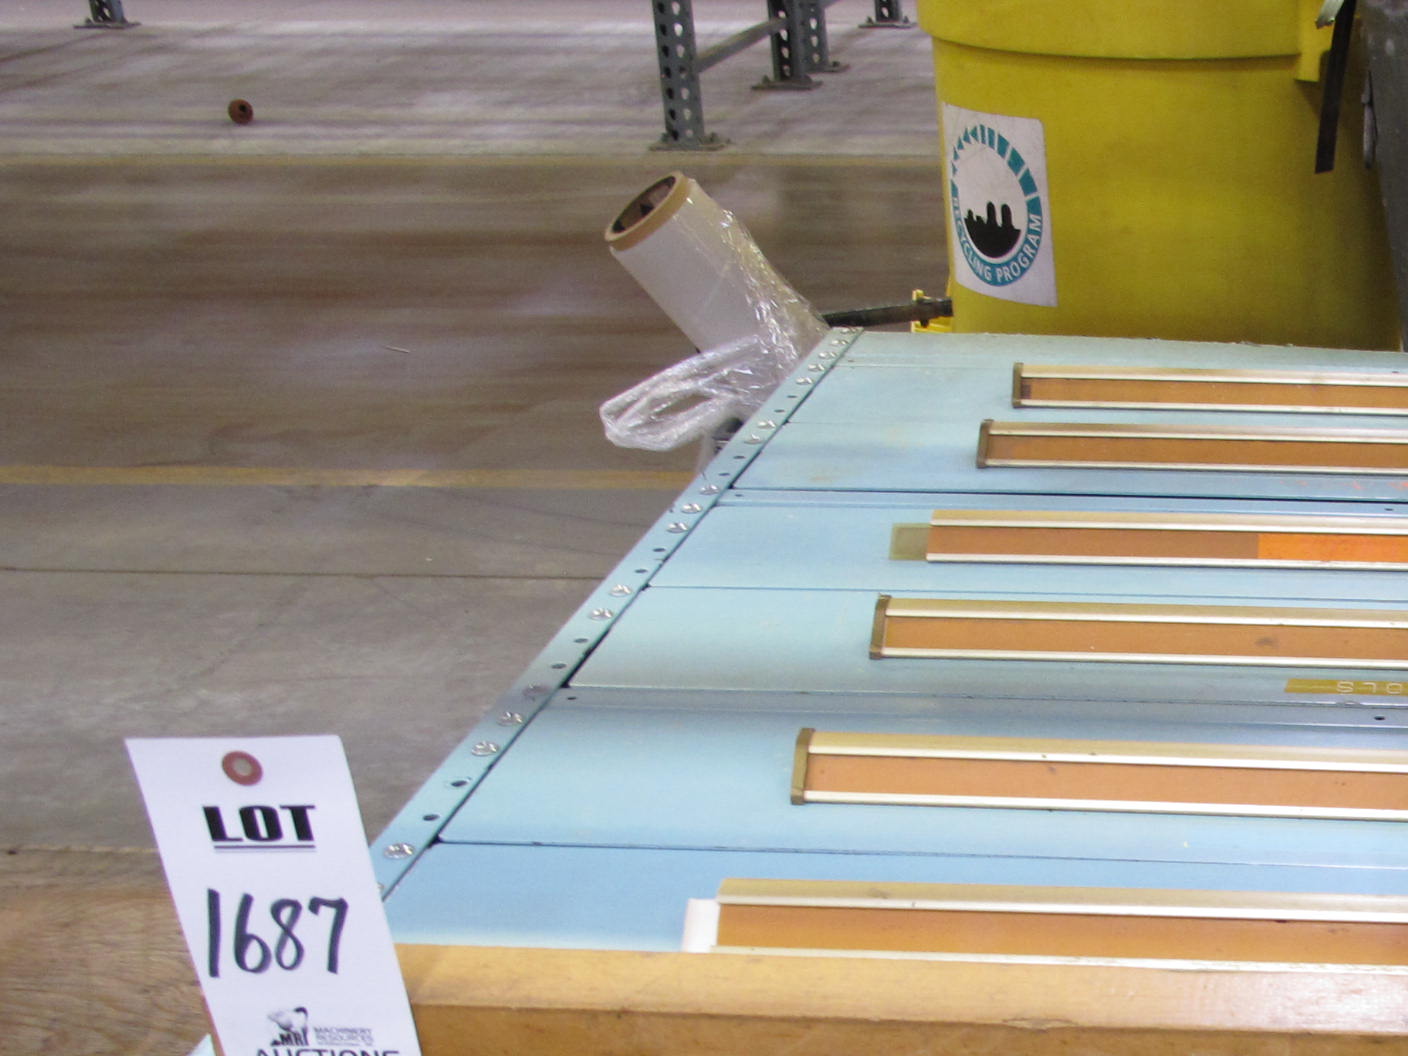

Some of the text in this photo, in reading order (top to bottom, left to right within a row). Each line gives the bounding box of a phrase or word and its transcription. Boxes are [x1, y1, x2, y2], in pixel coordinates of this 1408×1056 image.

[995, 213, 1042, 283] PROGRAM
[202, 804, 317, 843] LOT
[207, 887, 349, 979] 1687
